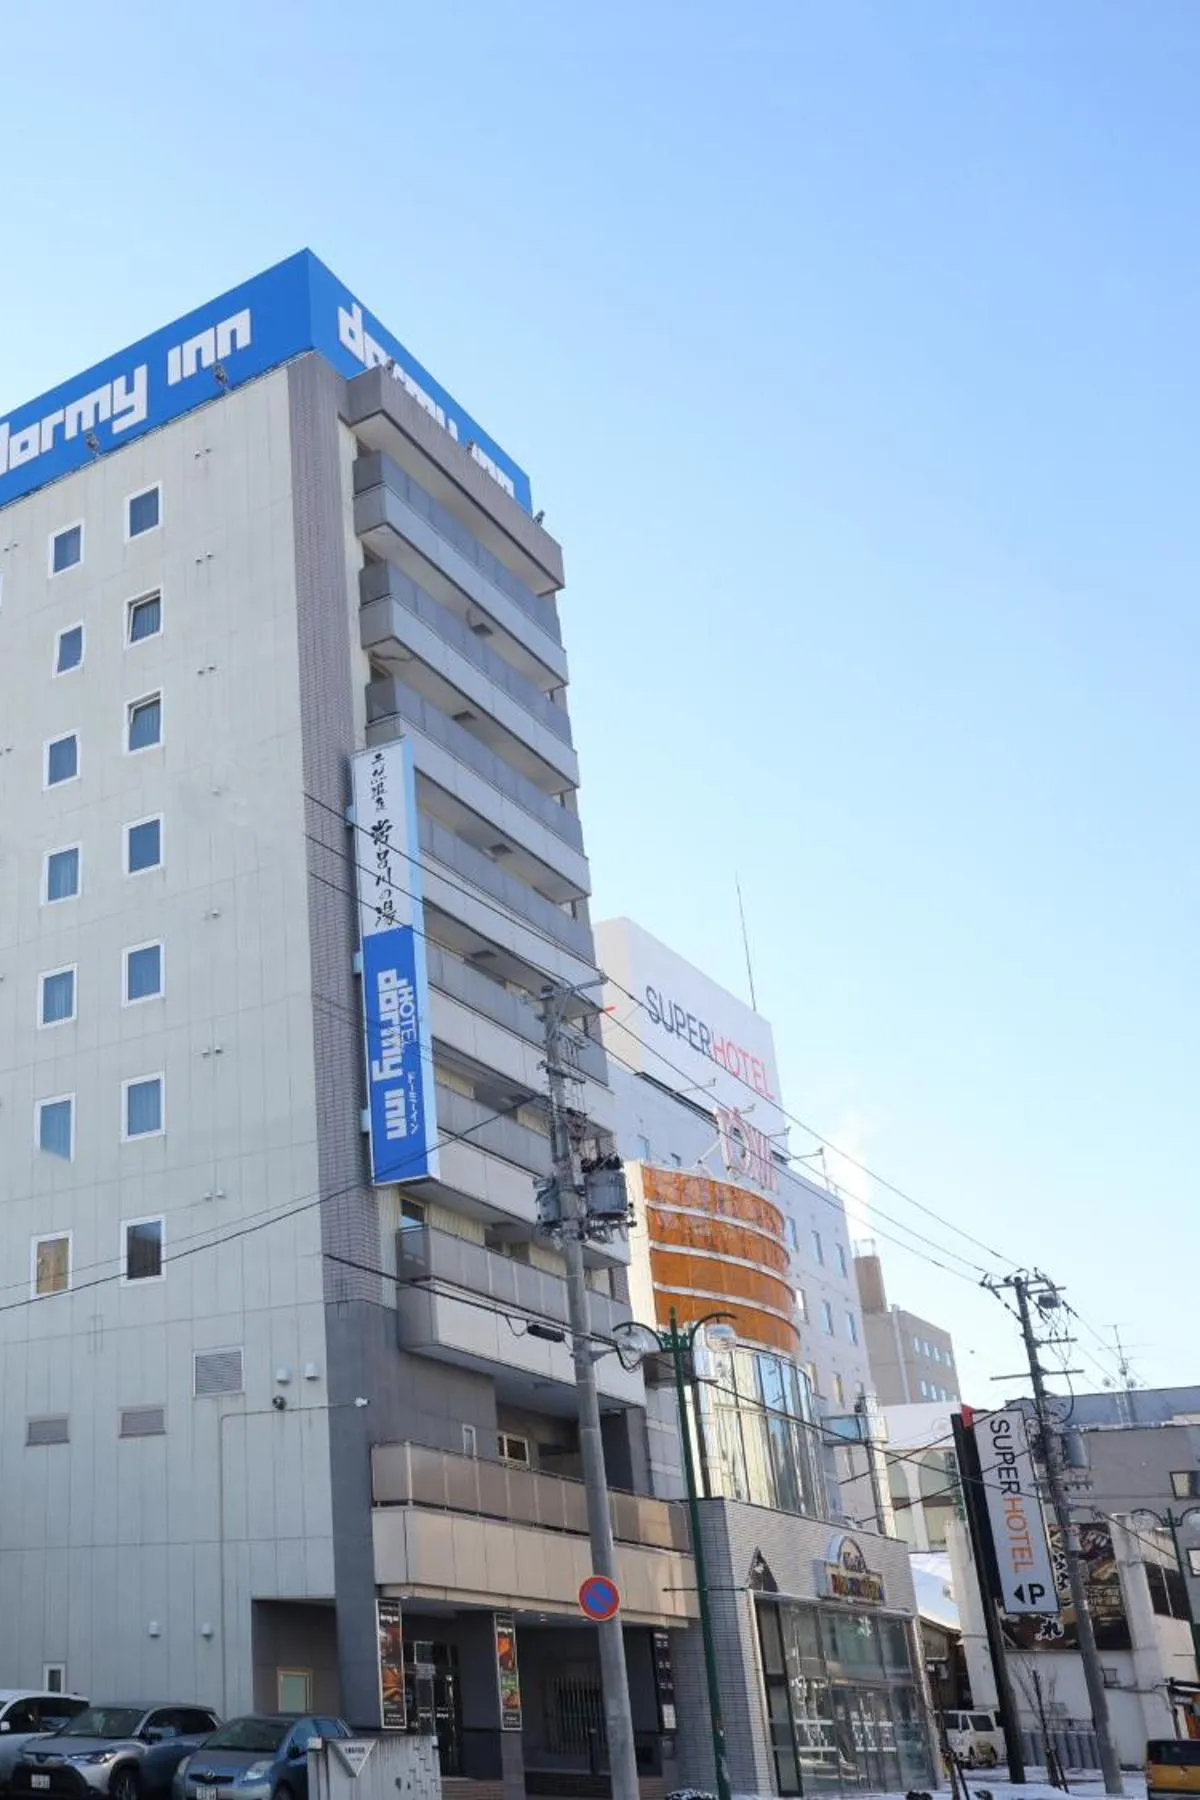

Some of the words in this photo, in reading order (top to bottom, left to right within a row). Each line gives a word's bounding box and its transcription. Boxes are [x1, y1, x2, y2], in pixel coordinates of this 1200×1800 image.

[167, 309, 251, 386] inn
[372, 969, 408, 1082] dormy
[384, 1088, 408, 1140] inn
[1028, 1583, 1046, 1605] P
